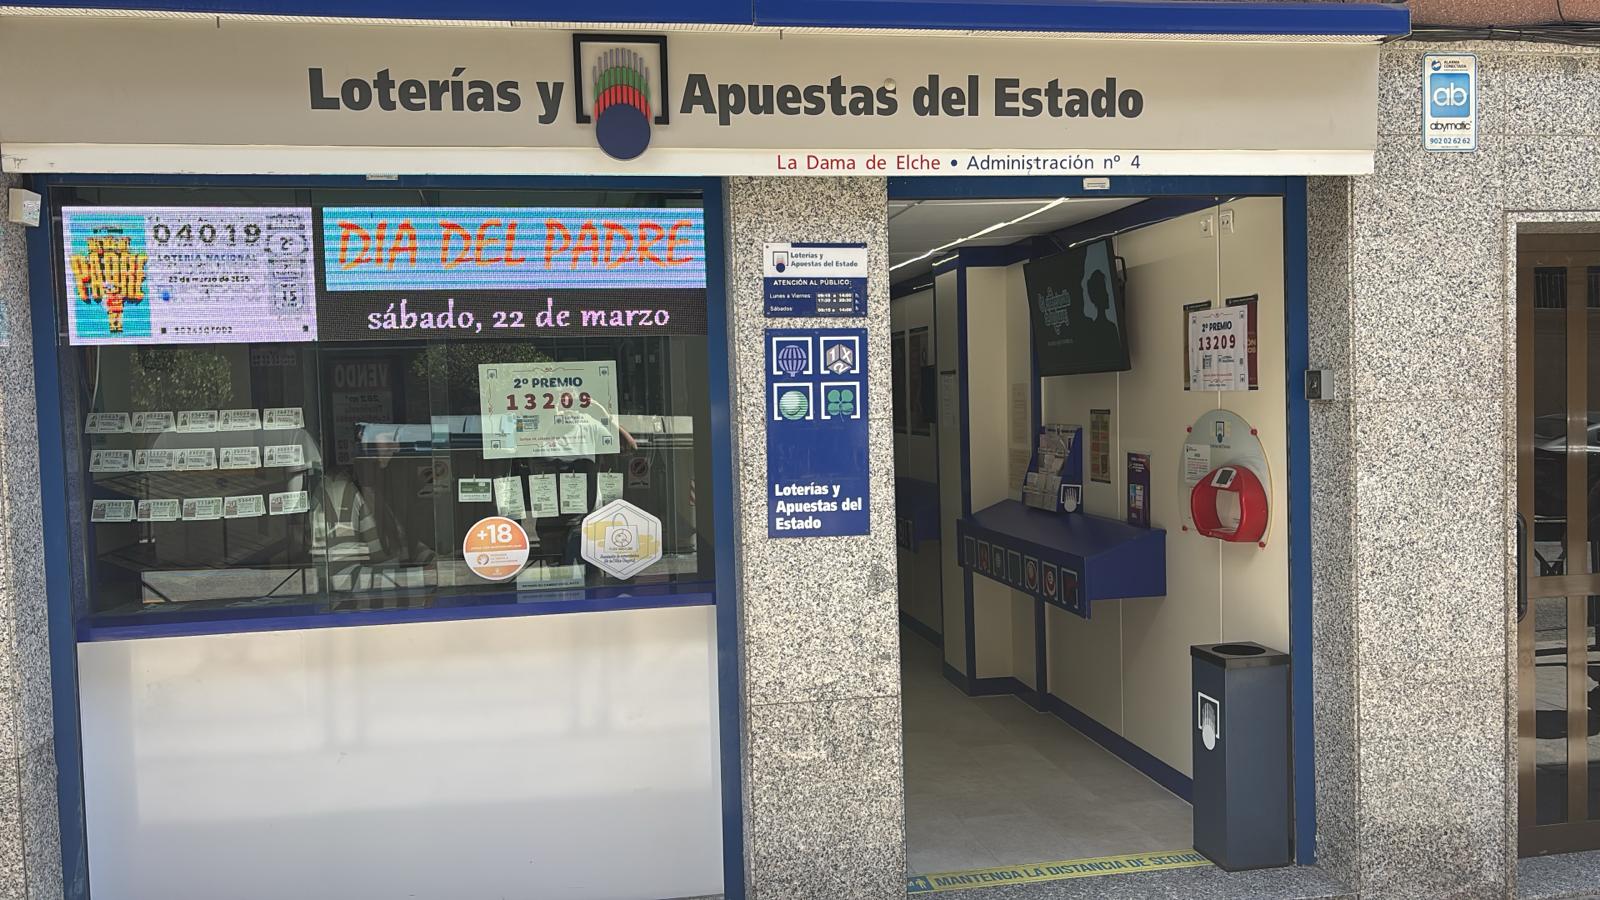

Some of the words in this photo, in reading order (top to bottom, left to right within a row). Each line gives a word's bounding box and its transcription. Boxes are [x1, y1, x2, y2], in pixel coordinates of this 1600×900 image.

[308, 66, 521, 112] Loterías
[536, 80, 564, 124] y
[680, 73, 899, 126] Apuestas
[913, 74, 980, 118] del
[994, 77, 1144, 118] Estado
[1433, 82, 1468, 107] ab
[1429, 121, 1471, 132] abymatic
[777, 154, 799, 170] La
[806, 155, 857, 171] Dama
[866, 154, 887, 171] de
[896, 154, 941, 171] Elche
[966, 154, 1095, 171] Administración
[1103, 154, 1121, 170] nº
[1130, 155, 1142, 170] 4
[152, 223, 262, 243] 04019
[336, 217, 418, 270] DIA
[439, 219, 526, 269] DEL
[543, 217, 694, 270] PADRE
[790, 260, 822, 268] Apuestas
[773, 278, 808, 286] ATENCIÓN
[367, 298, 483, 333] sábado,
[492, 310, 525, 328] 22
[535, 297, 570, 328] de
[580, 309, 670, 327] marzo
[1209, 320, 1233, 332] PREMIO
[1198, 334, 1236, 351] 13209
[513, 378, 529, 389] 2º
[532, 376, 583, 389] PREMIO
[506, 391, 592, 411] 13209
[774, 482, 829, 497] Loterías
[832, 484, 841, 498] y
[775, 499, 838, 516] Apuestas
[841, 497, 862, 511] del
[775, 516, 822, 530] Estado
[476, 523, 513, 544] +18
[935, 870, 1024, 887] MANTENGA
[1023, 866, 1047, 878] LA
[1046, 859, 1127, 876] DISTANCIA
[1126, 857, 1150, 868] DE
